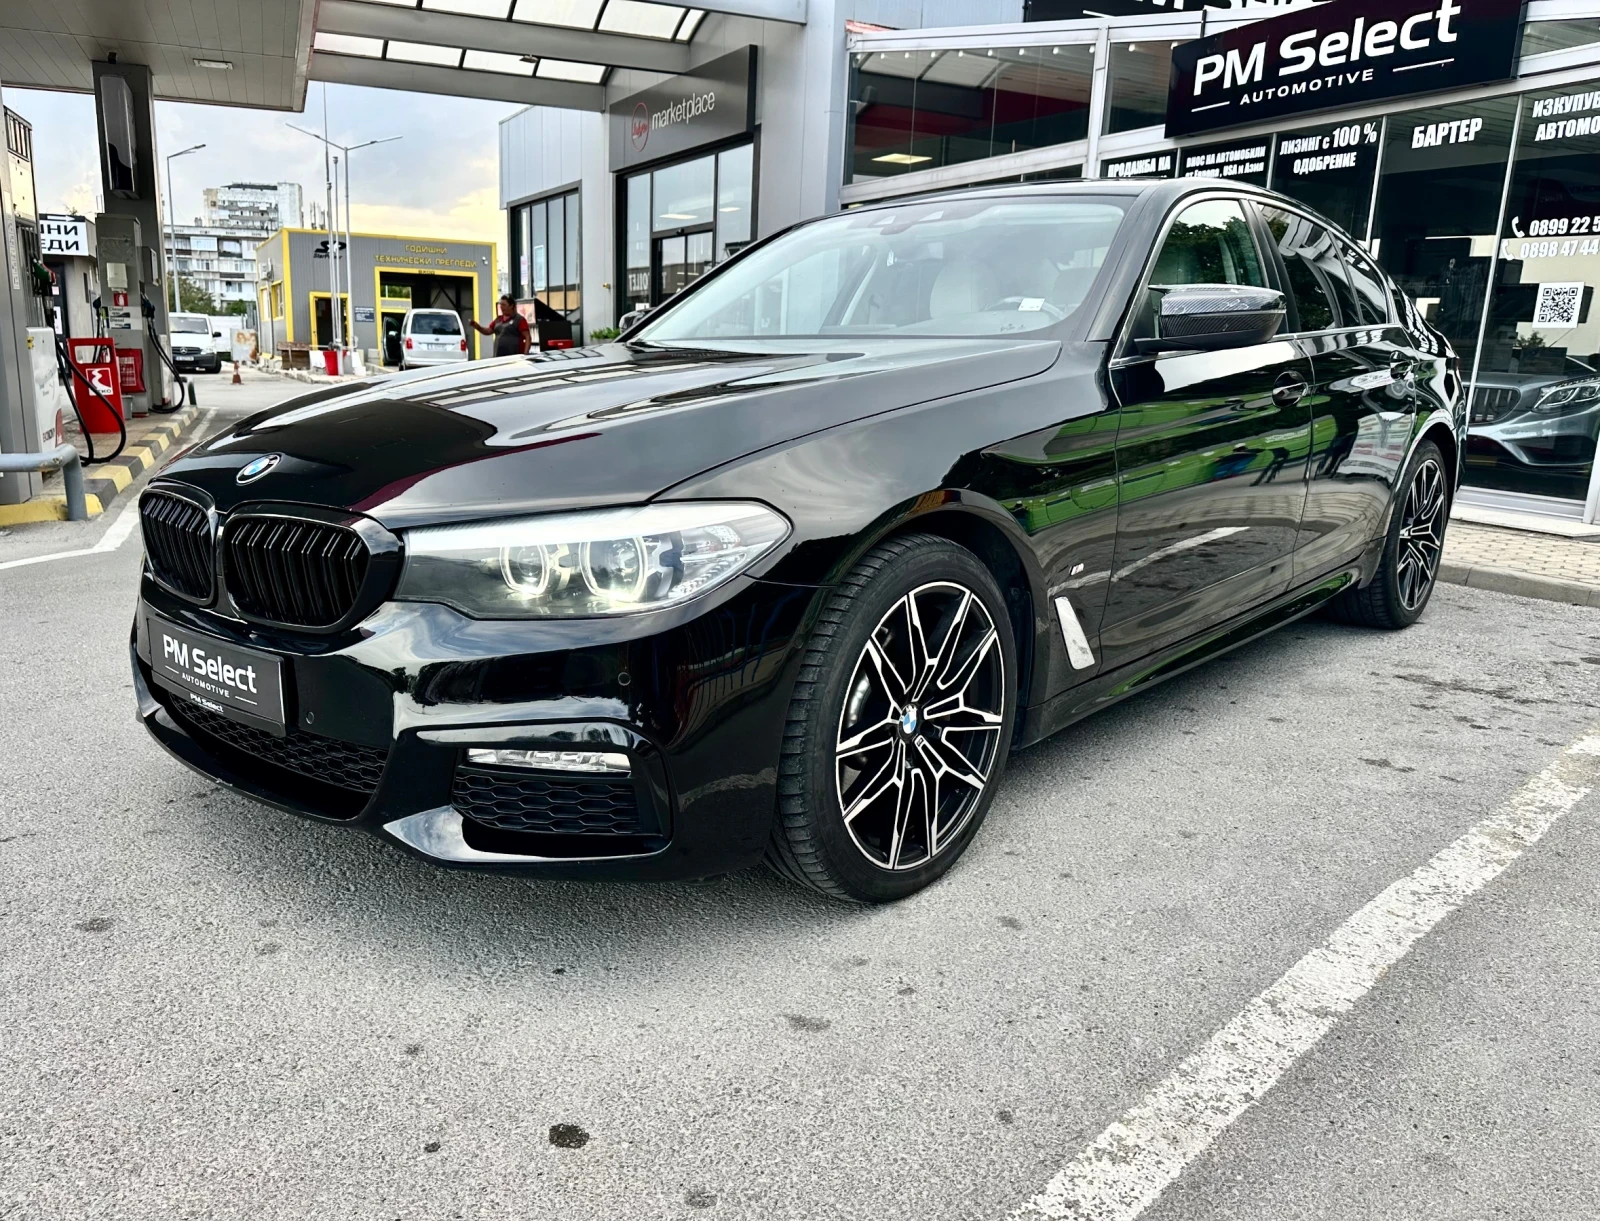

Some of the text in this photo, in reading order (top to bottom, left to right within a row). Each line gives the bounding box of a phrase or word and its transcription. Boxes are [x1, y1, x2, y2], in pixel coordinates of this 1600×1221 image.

[1193, 0, 1461, 96] PM Select
[1240, 68, 1374, 105] AUTOMOTIVE
[652, 91, 715, 130] marketplace
[1279, 136, 1322, 155] ЛИЗИНГ
[1332, 125, 1361, 148] 100
[1411, 117, 1483, 149] БАРТЕР
[1534, 115, 1600, 141] АВТОМО
[1108, 155, 1171, 177] ПРОДАЖБА НА
[1186, 146, 1266, 168] ВНОС НА АВТОМОБИЛИ
[1223, 164, 1237, 176] USA
[1244, 162, 1264, 173] Азия
[1293, 151, 1357, 175] ОДОБРЕНИЕ
[1529, 218, 1569, 236] 0899
[1569, 215, 1591, 233] 22
[405, 244, 448, 254] ГОДИШНИ
[1520, 238, 1600, 259] 0898 47 44
[374, 254, 477, 268] ТЕХНИЧЕСКИ ПРЕГЛЕДИ
[163, 633, 258, 694] PM Select
[182, 672, 230, 698] AUTOMOTIVE
[190, 692, 224, 713] PM Select
